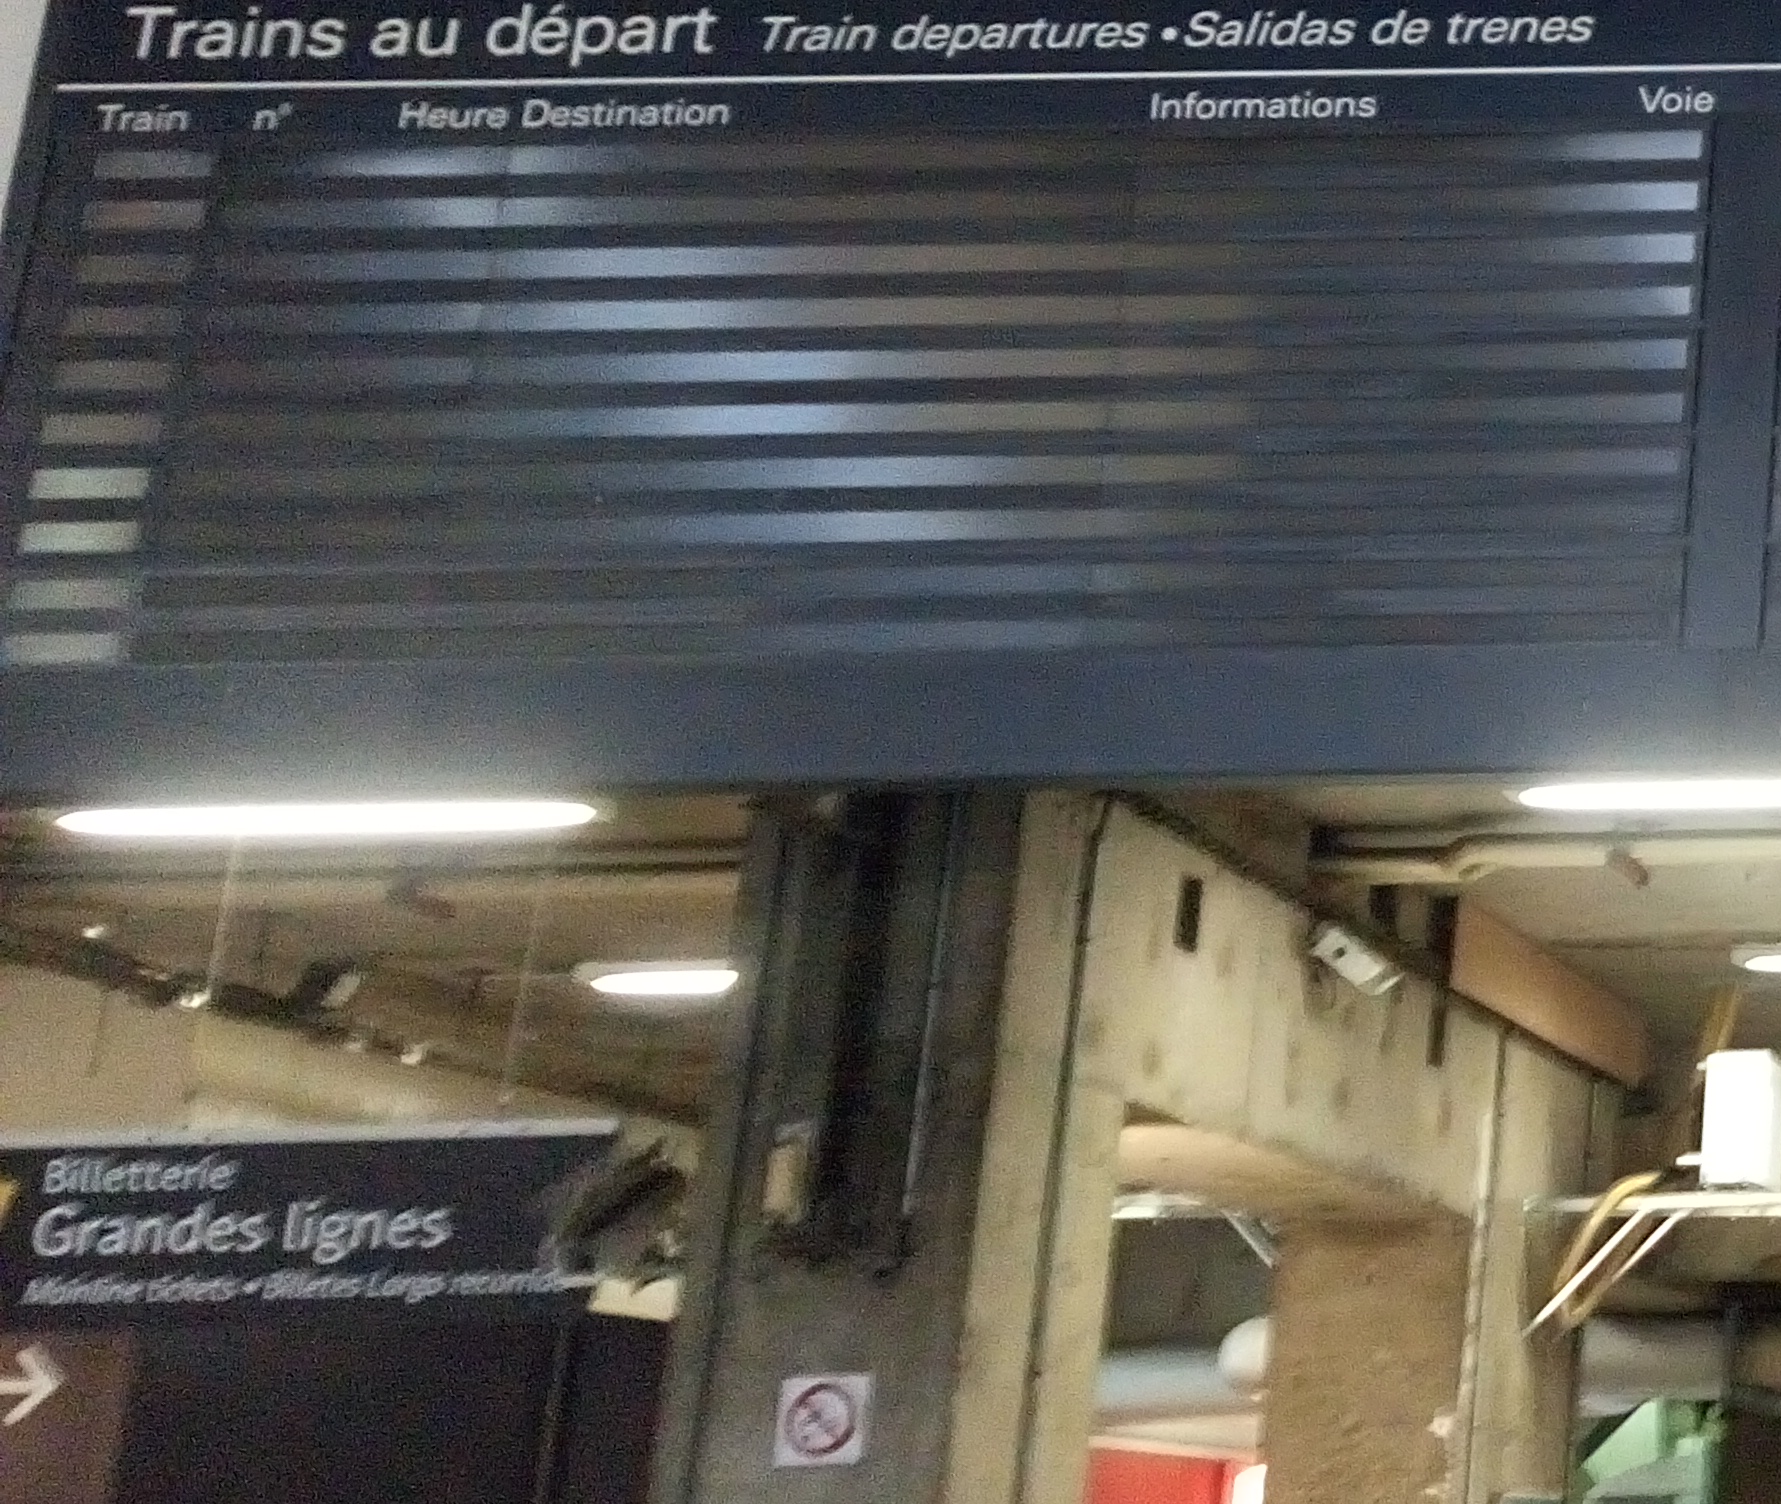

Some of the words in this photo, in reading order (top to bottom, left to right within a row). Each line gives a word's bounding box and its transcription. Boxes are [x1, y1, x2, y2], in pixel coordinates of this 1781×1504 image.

[124, 6, 347, 62] Trains
[369, 14, 459, 59] au
[485, 3, 718, 66] départ
[760, 15, 876, 53] Train
[890, 12, 1150, 58] departures
[1183, 9, 1362, 48] Salidas
[1370, 9, 1432, 46] de
[1446, 8, 1595, 45] trenes
[96, 102, 190, 134] Train
[398, 101, 508, 131] Heure
[520, 98, 731, 130] Destination
[1150, 91, 1378, 120] Informations
[1637, 84, 1716, 116] Voie
[44, 1152, 240, 1194] Billetterie
[31, 1198, 270, 1257] Grandes
[282, 1196, 452, 1265] lignes
